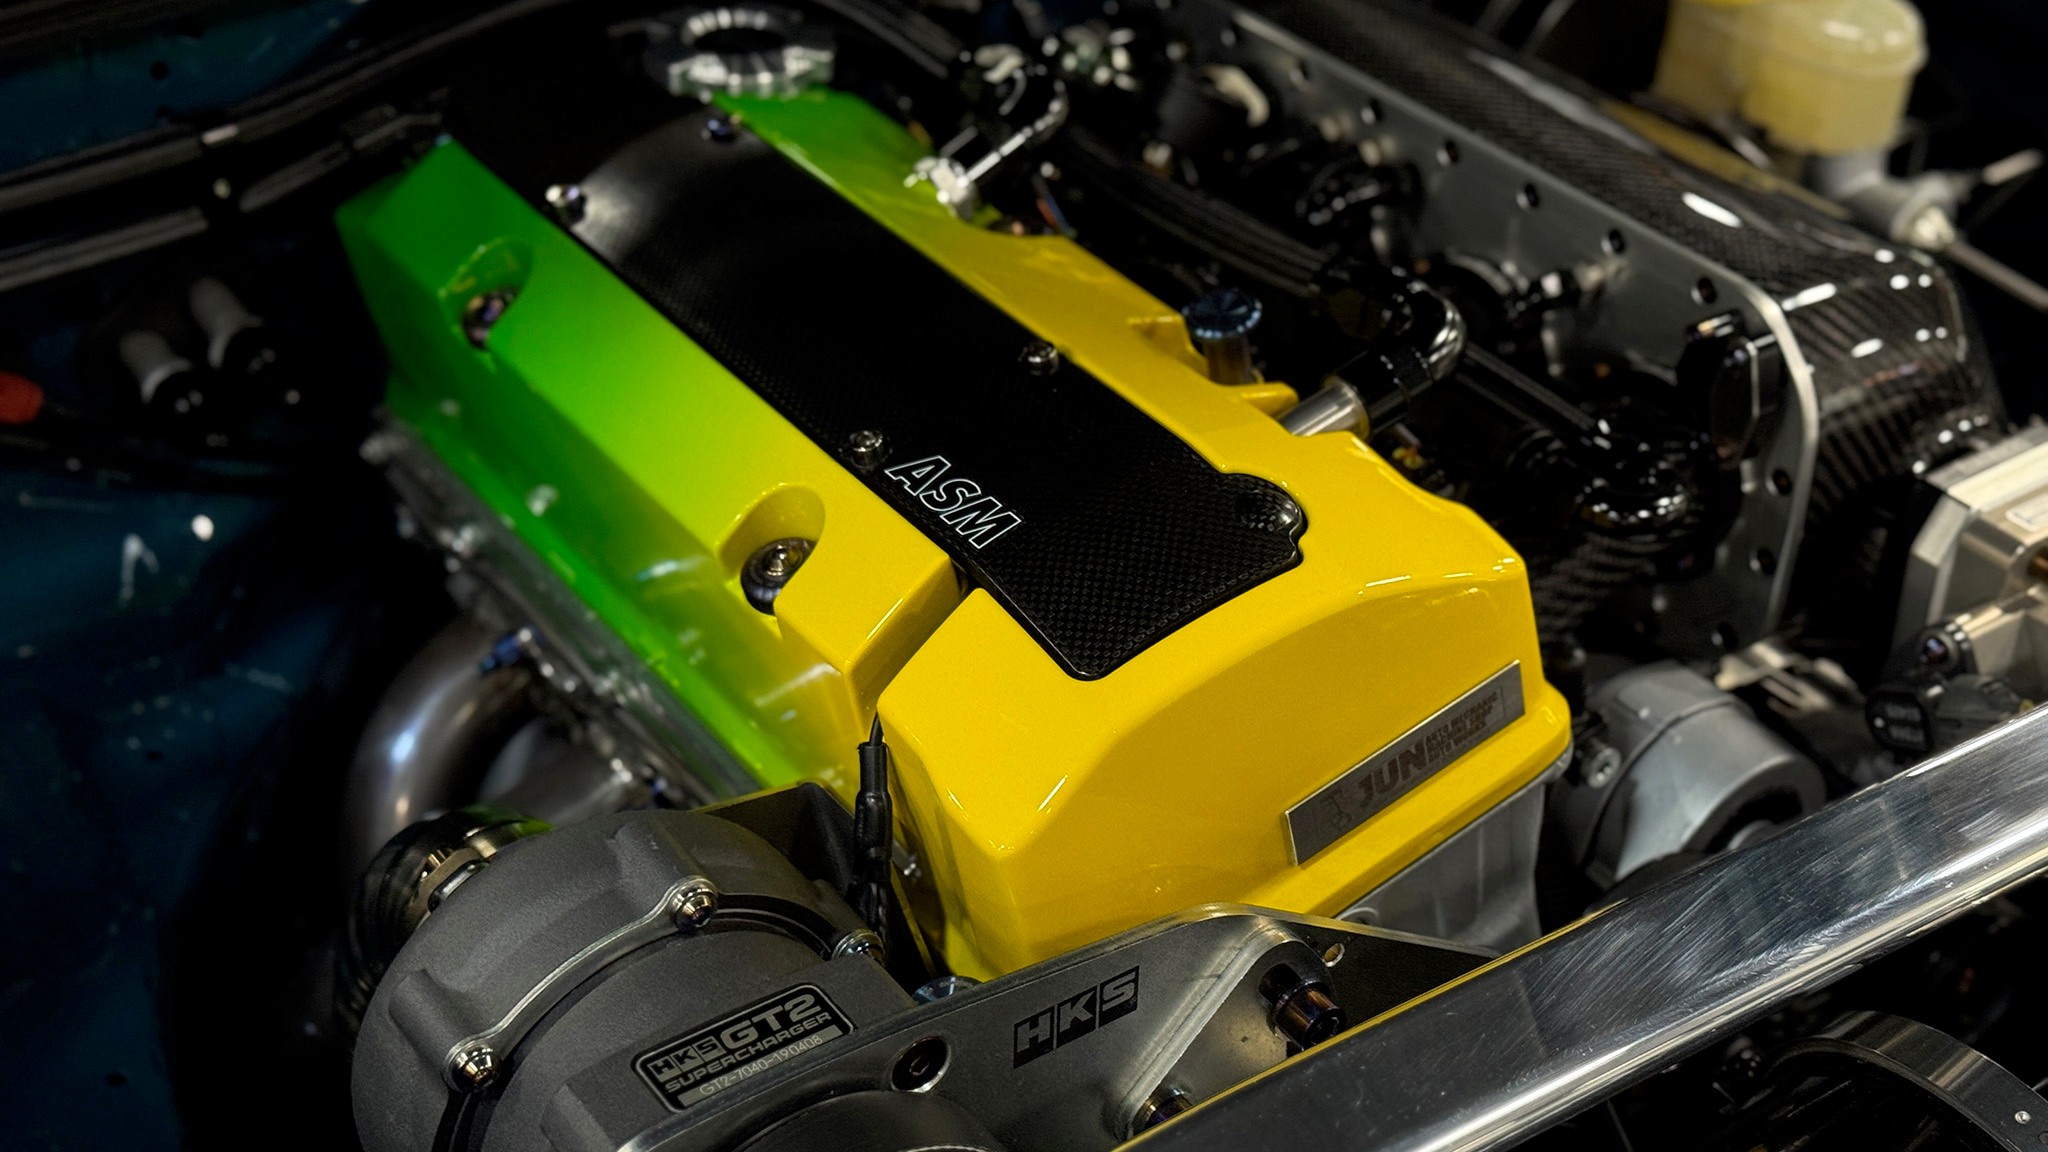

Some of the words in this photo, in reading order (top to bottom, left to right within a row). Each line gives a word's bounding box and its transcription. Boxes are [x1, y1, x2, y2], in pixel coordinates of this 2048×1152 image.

[884, 455, 1022, 549] ASM
[1357, 741, 1427, 808] JUN
[647, 1035, 727, 1083] HKS
[719, 994, 822, 1050] GT2
[664, 1011, 832, 1093] SUPERCHARGER
[1014, 968, 1139, 1062] HKS
[699, 1034, 823, 1096] GT2-7040-190408
